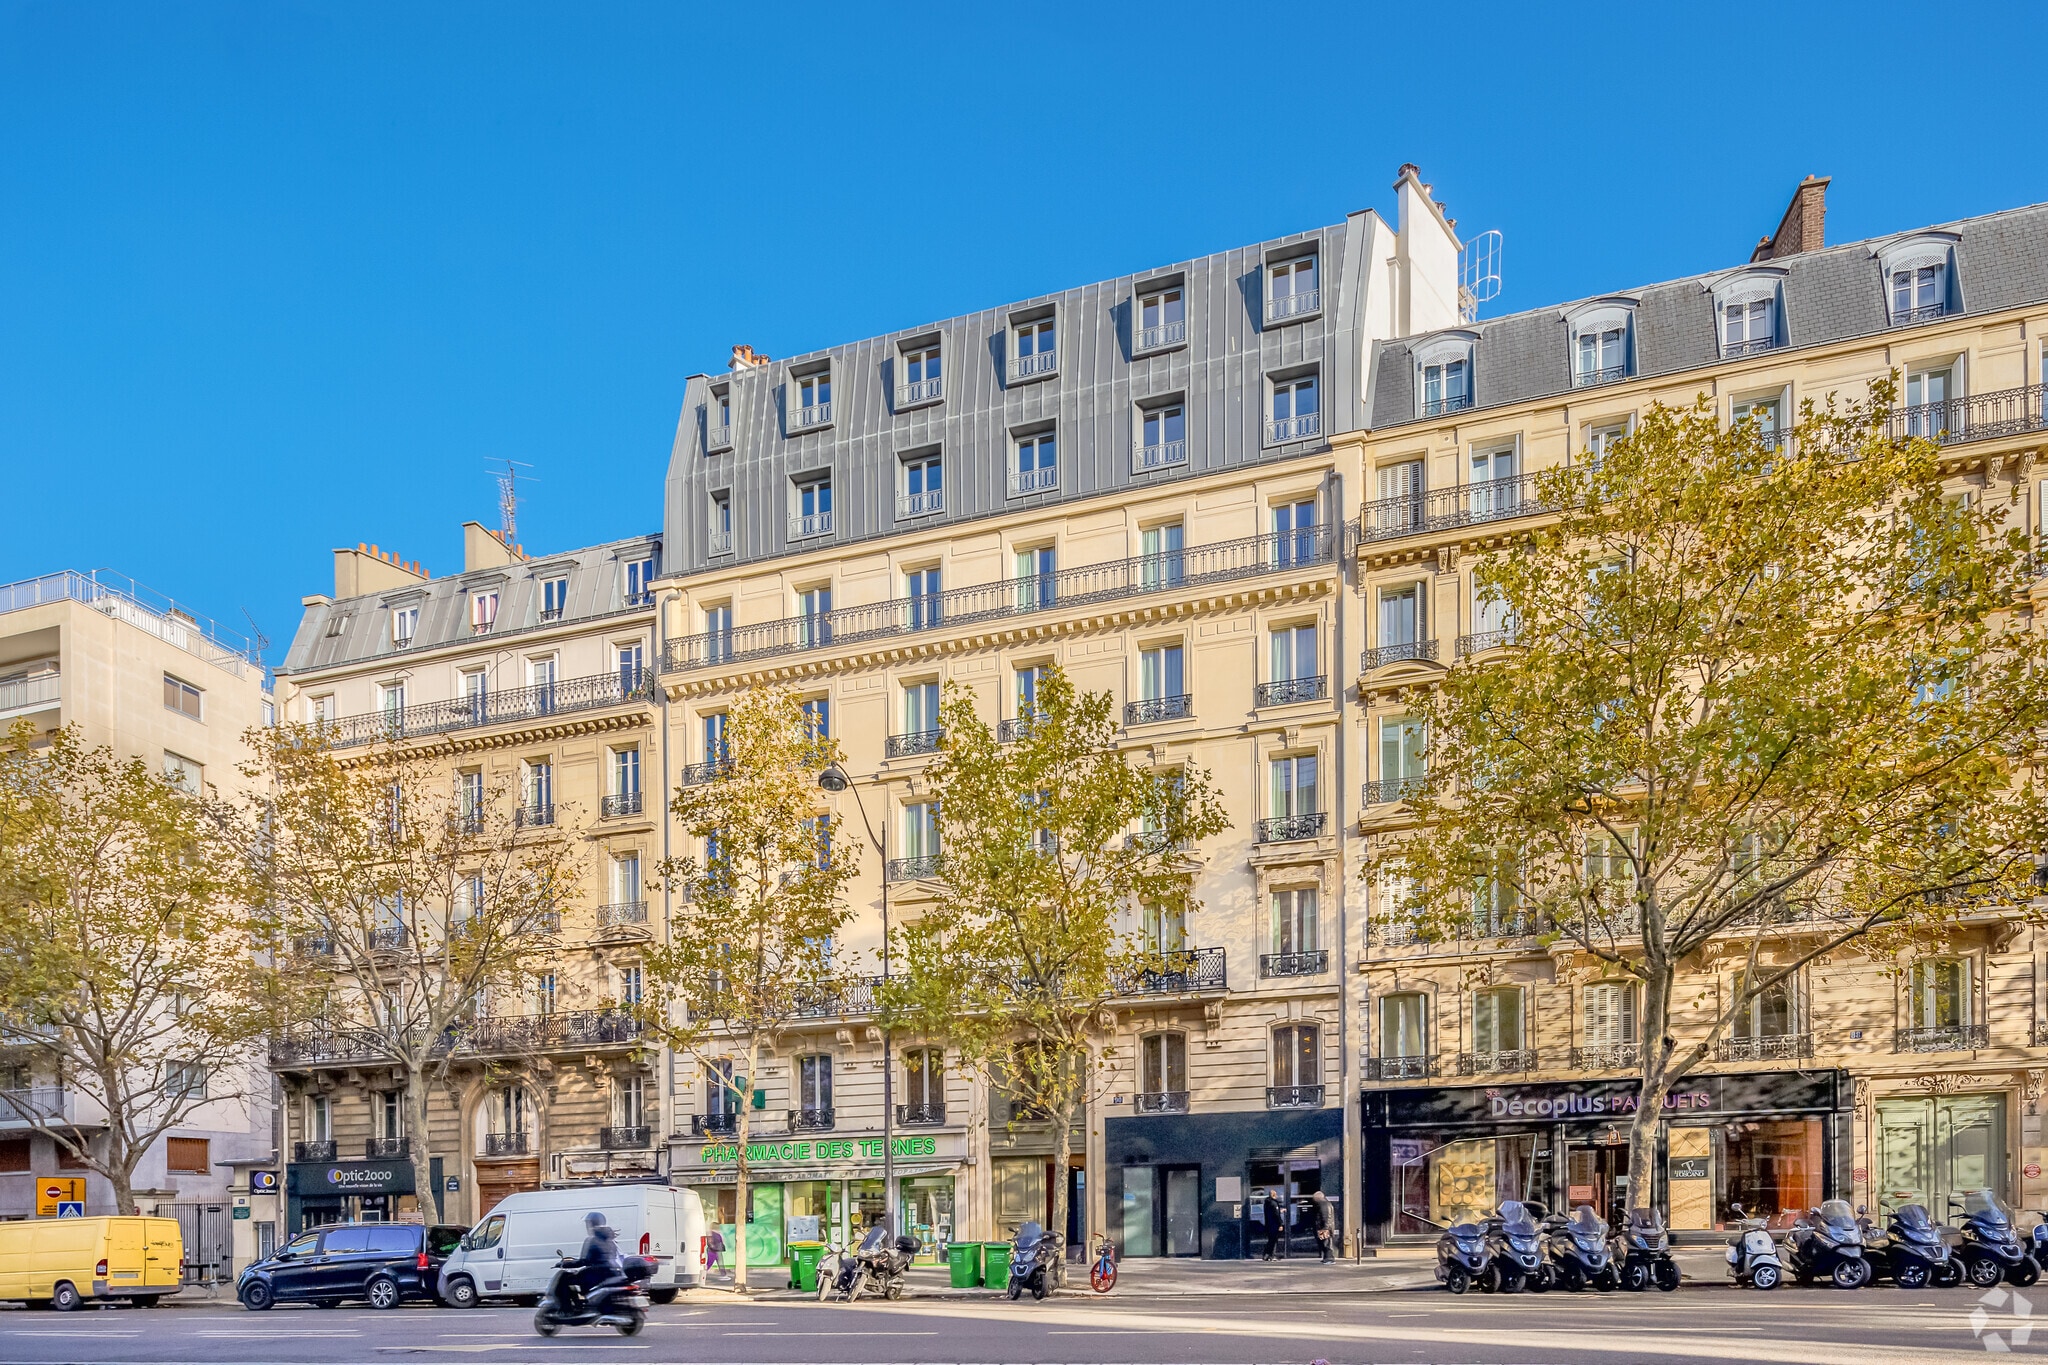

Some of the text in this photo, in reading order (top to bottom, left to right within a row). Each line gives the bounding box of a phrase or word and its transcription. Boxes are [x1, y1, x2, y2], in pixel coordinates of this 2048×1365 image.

[1491, 1093, 1710, 1118] Décoplus PAUETS
[816, 1142, 853, 1159] DES
